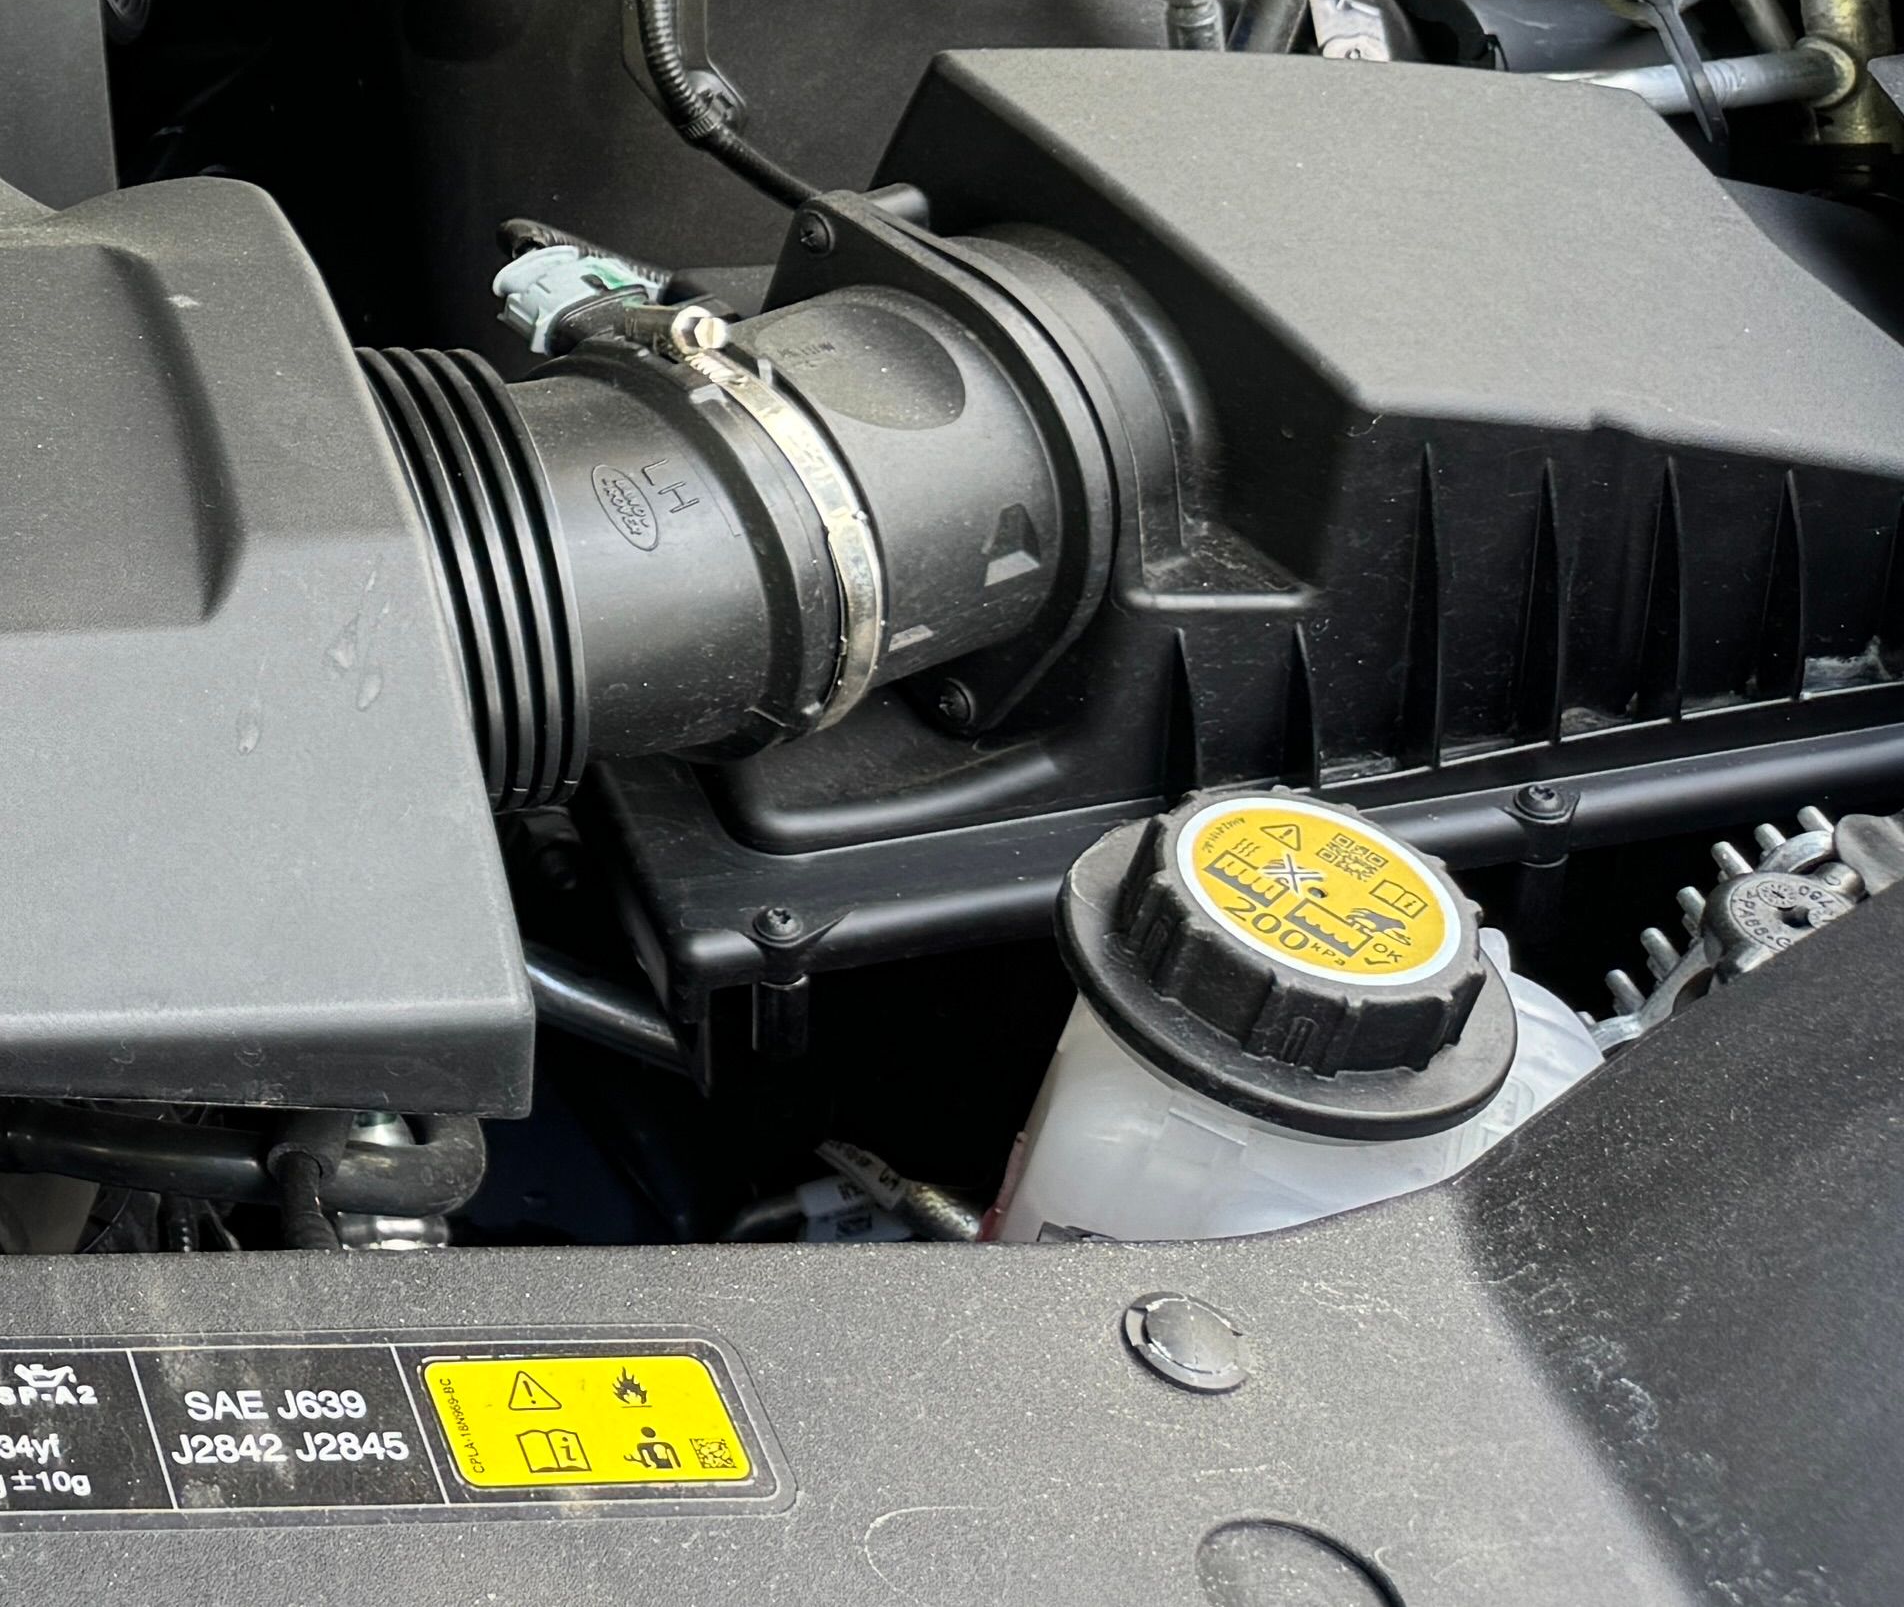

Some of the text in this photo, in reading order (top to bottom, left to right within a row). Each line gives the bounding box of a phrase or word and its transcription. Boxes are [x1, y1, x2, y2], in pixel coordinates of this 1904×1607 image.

[641, 458, 700, 514] LH
[1223, 895, 1346, 967] 200 kPa
[1372, 941, 1404, 963] OK
[183, 1389, 367, 1421] SAE J639
[171, 1430, 410, 1464] J2842 J2845
[12, 1470, 92, 1496] ±10g
